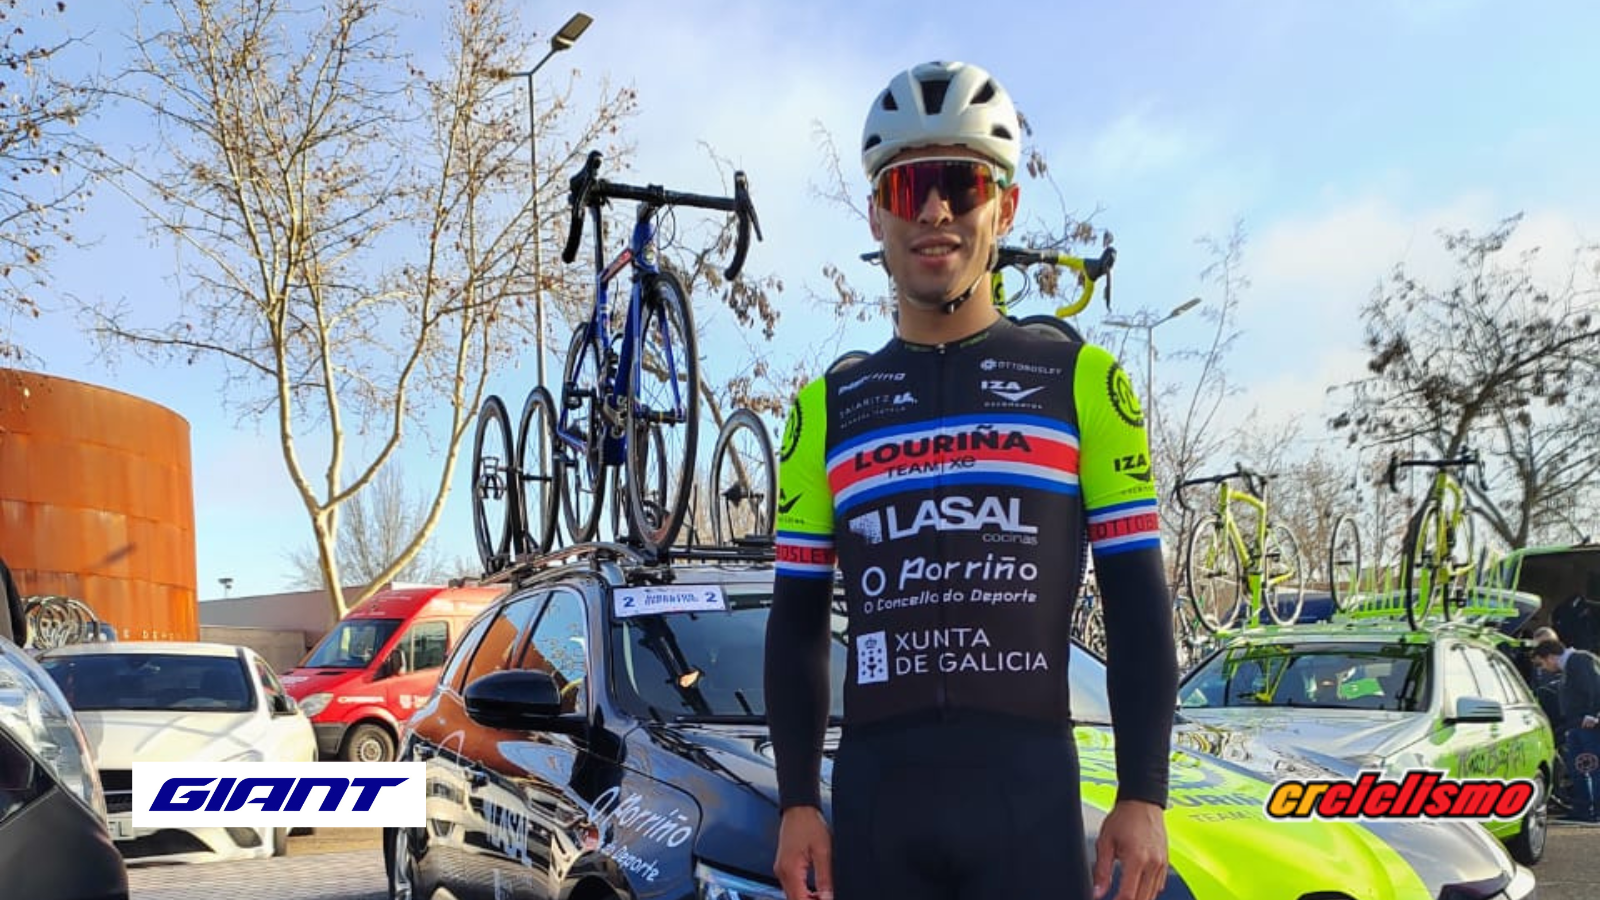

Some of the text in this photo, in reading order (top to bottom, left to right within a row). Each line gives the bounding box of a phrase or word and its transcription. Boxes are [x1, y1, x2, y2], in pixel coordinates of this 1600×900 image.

[981, 381, 1021, 391] IZA
[854, 424, 1032, 472] LOURIÑA
[886, 455, 977, 478] TEAM xe
[1114, 453, 1148, 472] IZA
[886, 495, 1039, 541] LASAL
[981, 532, 1039, 546] cocinas
[861, 552, 1038, 597] O Porriño
[623, 596, 635, 608] 2
[705, 591, 717, 603] 2
[877, 593, 939, 611] Concello
[943, 588, 964, 603] do
[972, 587, 1038, 605] Deporte
[895, 627, 991, 652] XUNTA
[895, 651, 1050, 676] DE GALICIA
